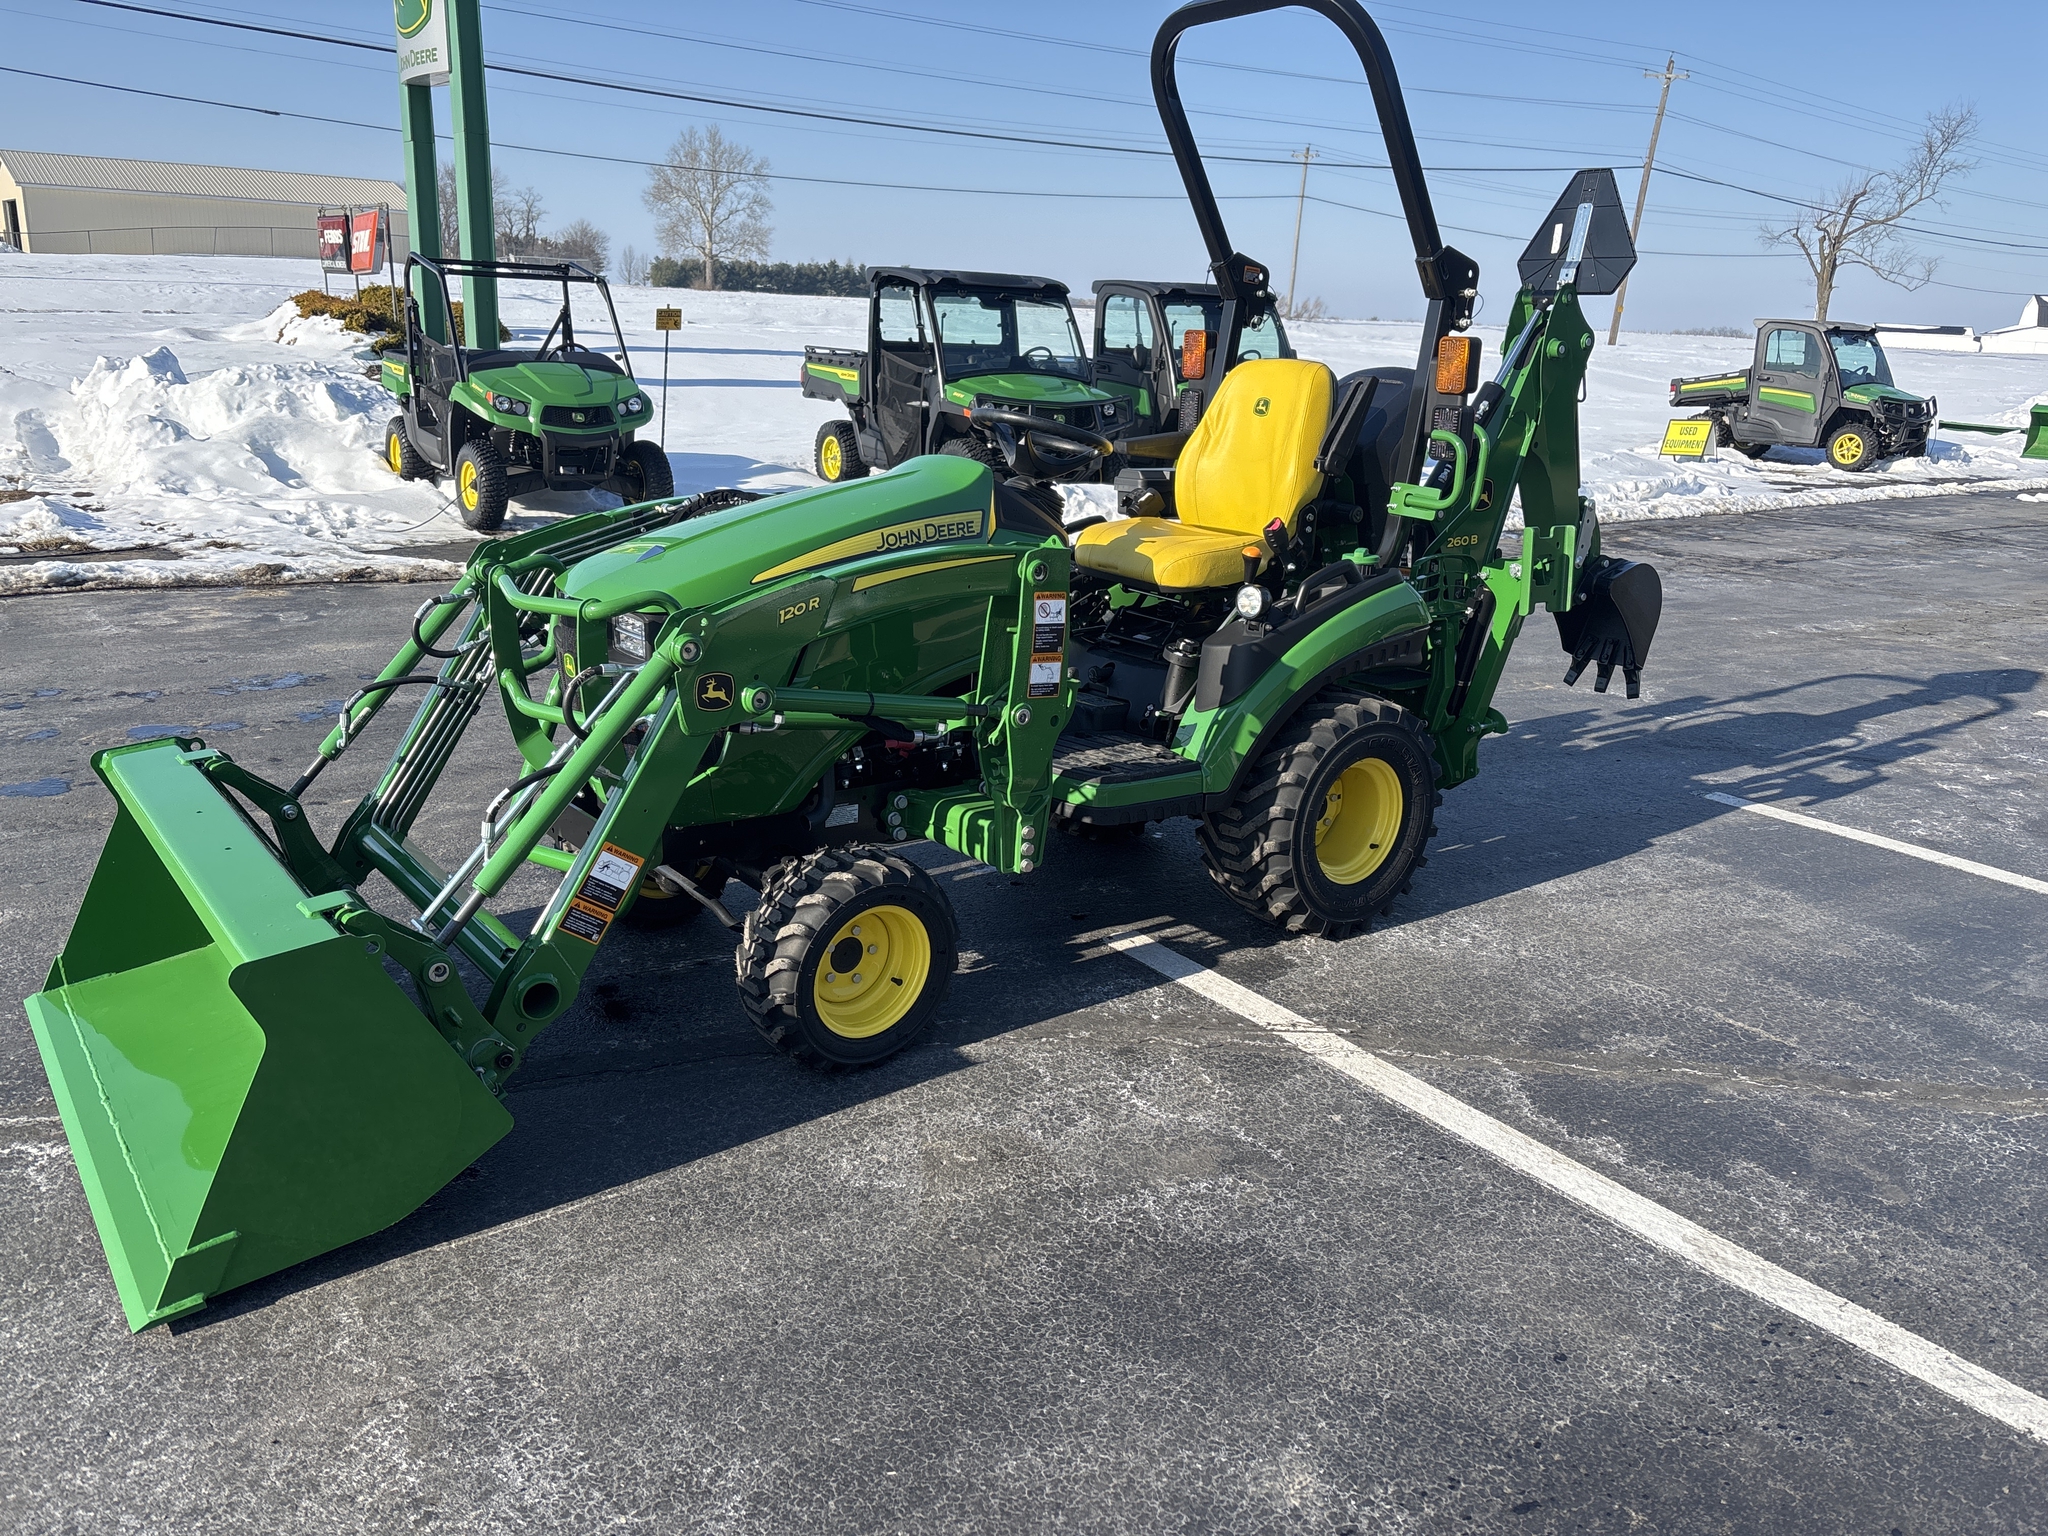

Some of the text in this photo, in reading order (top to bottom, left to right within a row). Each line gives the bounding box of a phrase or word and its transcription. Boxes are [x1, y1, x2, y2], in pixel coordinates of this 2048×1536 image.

[410, 47, 438, 68] DEERE
[1679, 426, 1698, 436] USED
[1664, 438, 1705, 449] EQUIPMENT
[876, 520, 976, 550] JOHN DEERE
[1446, 534, 1479, 548] 260 B
[779, 596, 820, 624] 120 R
[613, 848, 640, 864] WARNING
[582, 904, 609, 920] WARNING
